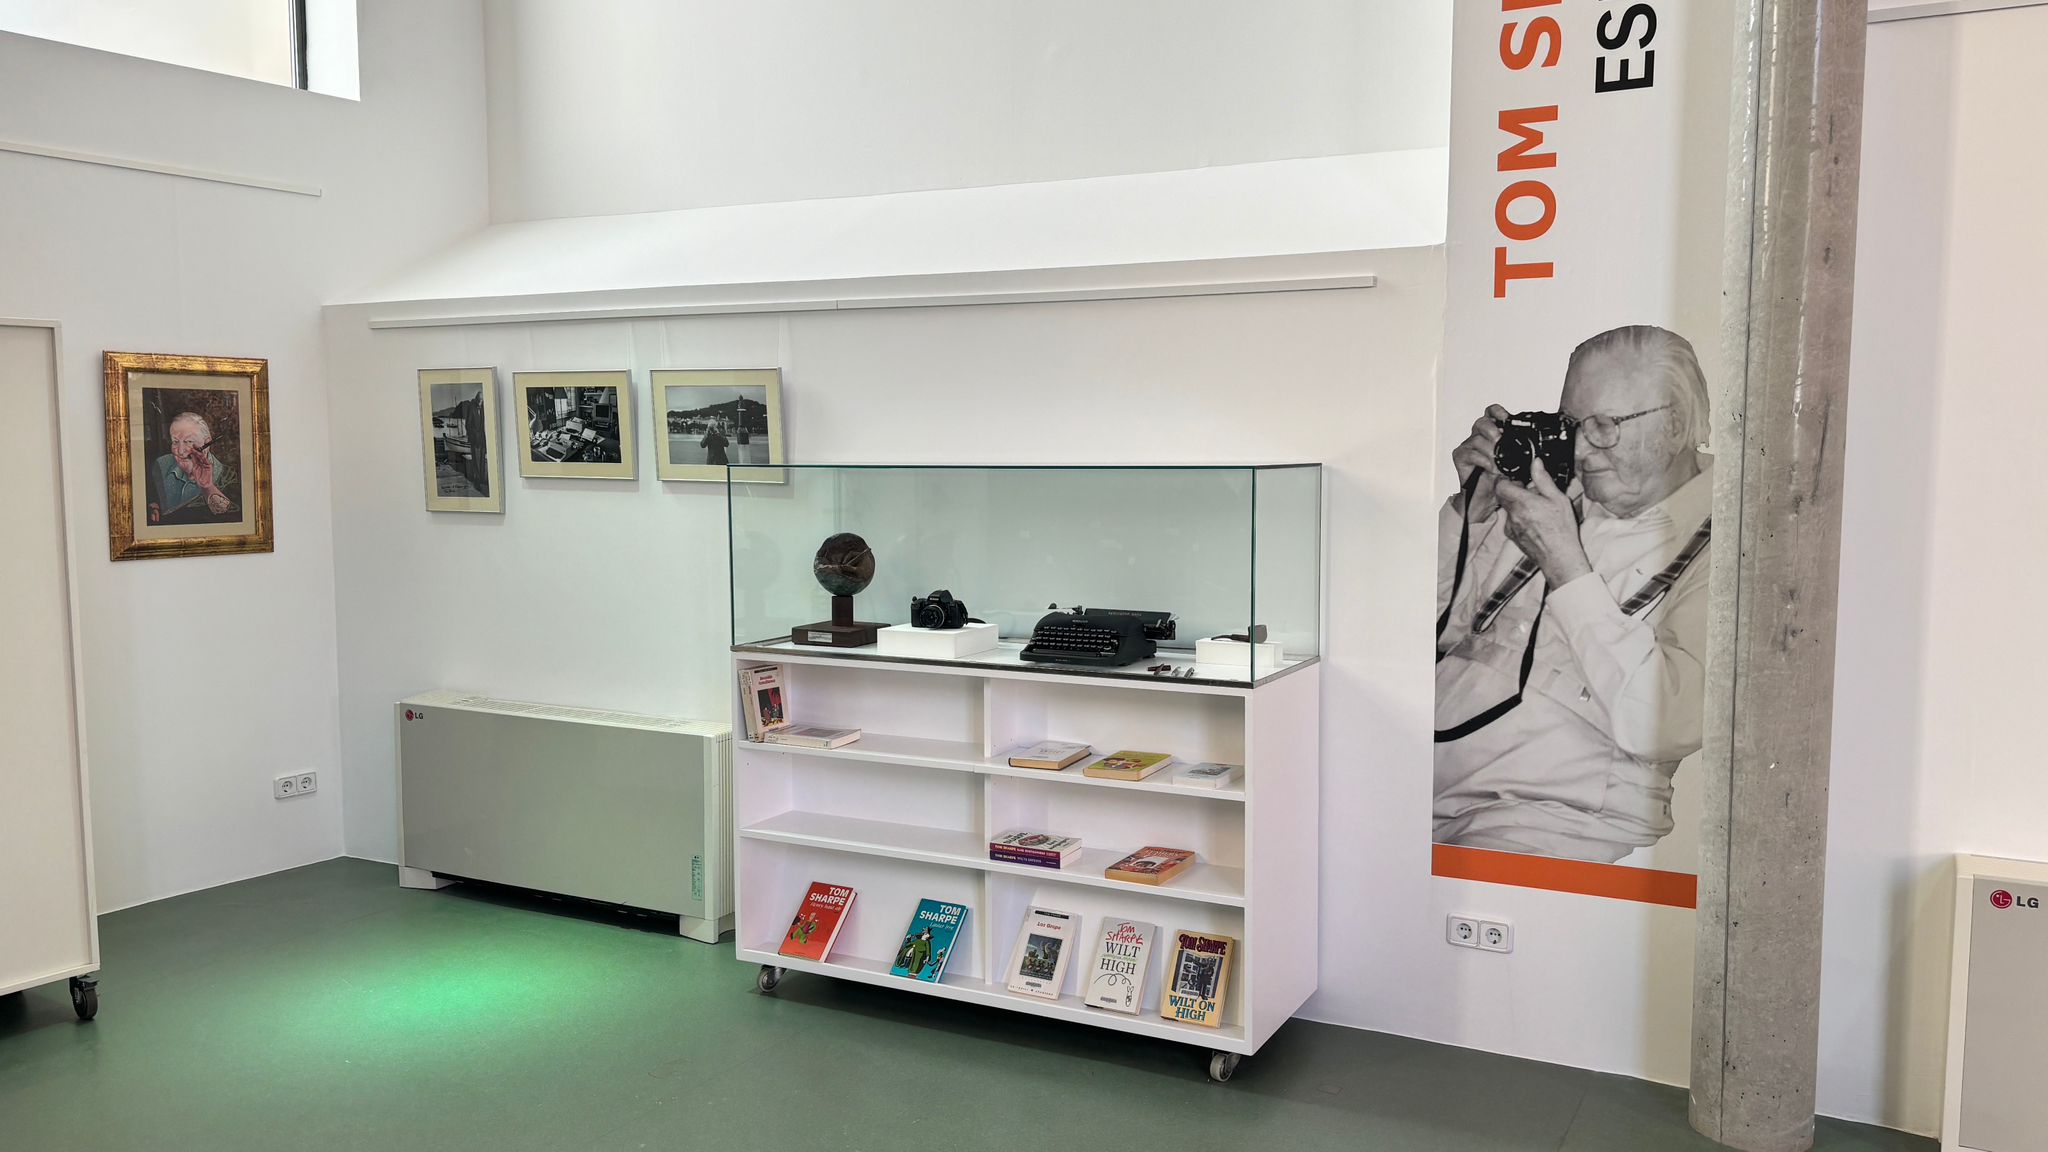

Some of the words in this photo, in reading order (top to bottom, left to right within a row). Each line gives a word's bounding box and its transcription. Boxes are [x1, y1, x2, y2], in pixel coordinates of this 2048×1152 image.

[1499, 0, 1563, 70] S
[1494, 105, 1559, 298] TOM
[414, 712, 424, 720] LG
[810, 893, 845, 906] SHARPE
[829, 887, 849, 898] TOM
[2016, 896, 2039, 908] LG
[920, 910, 958, 925] SHARPE
[940, 904, 961, 916] TOM
[1106, 930, 1143, 945] SHARPE
[1106, 941, 1141, 958] WILT
[1100, 958, 1137, 975] HIGH
[1169, 995, 1197, 1009] WILT
[1199, 1000, 1215, 1012] ON
[1175, 1007, 1206, 1021] HIGH
